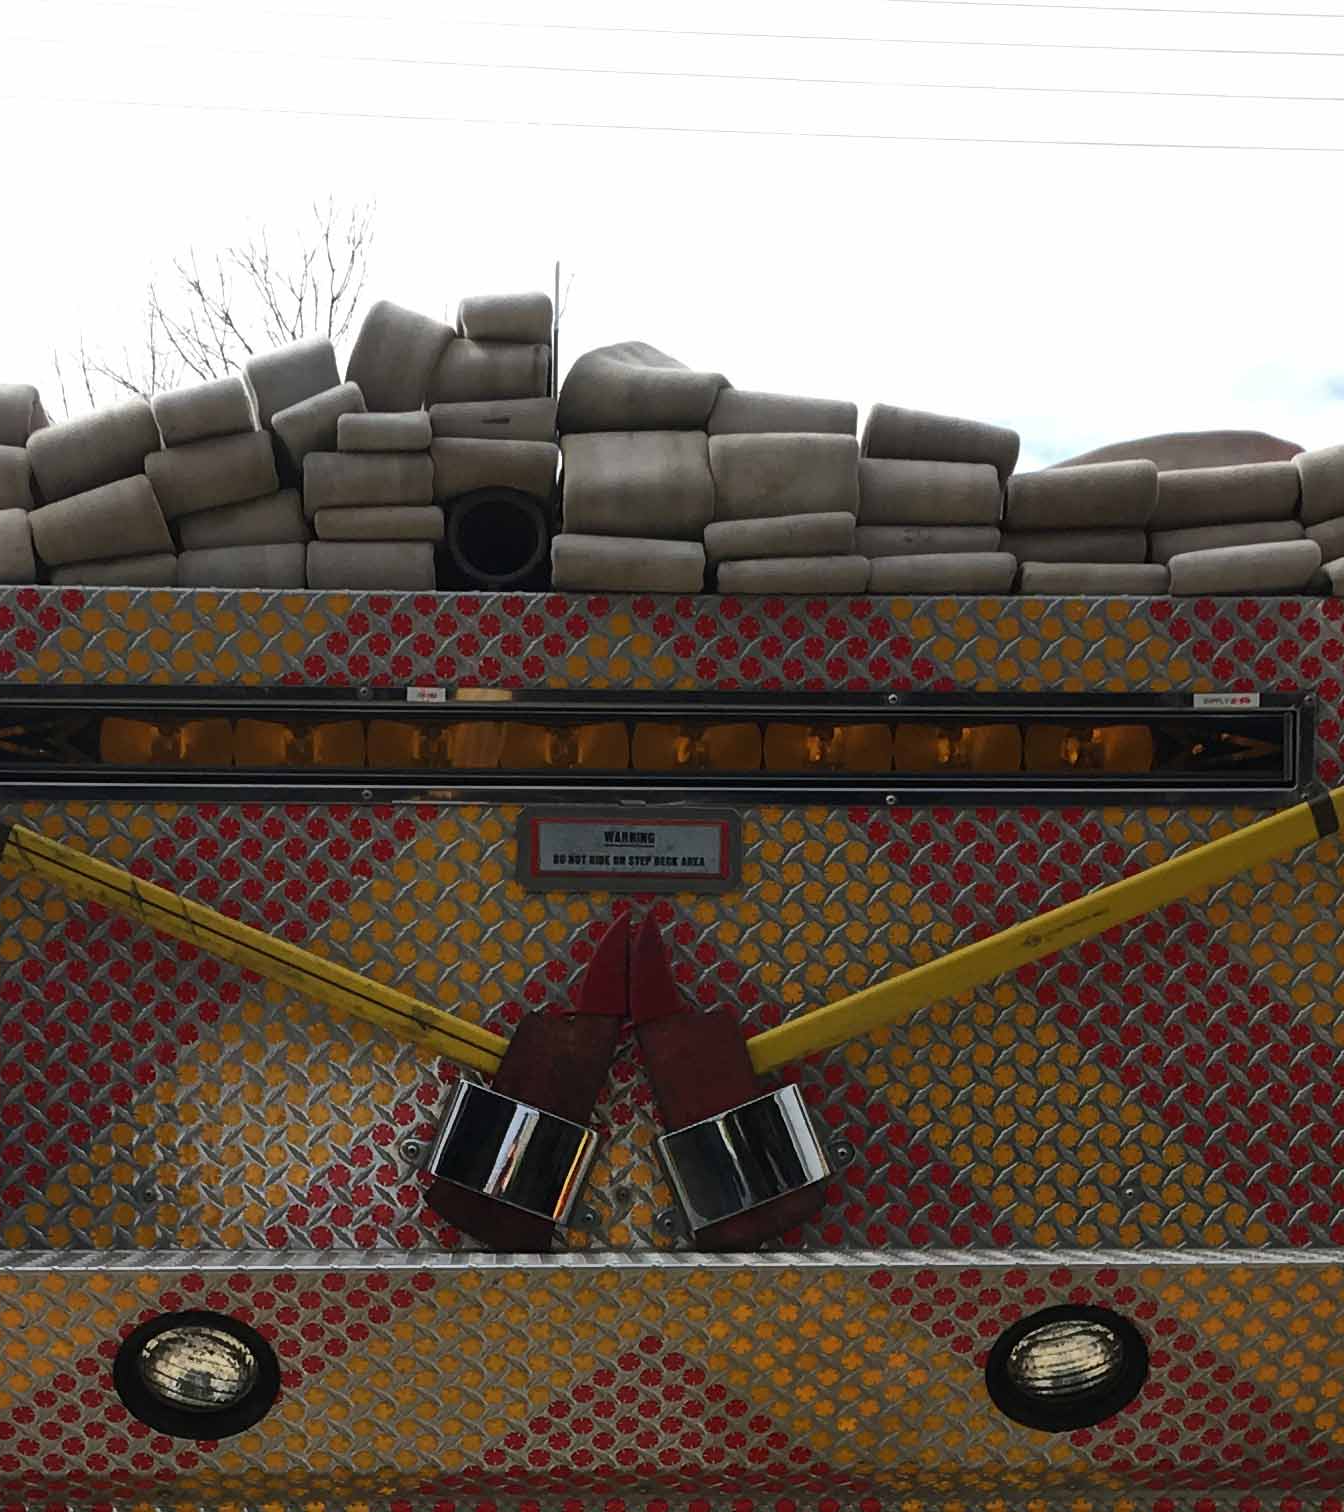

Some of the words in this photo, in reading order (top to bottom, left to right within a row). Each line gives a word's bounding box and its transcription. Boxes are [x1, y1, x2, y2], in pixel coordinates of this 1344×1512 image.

[604, 831, 656, 844] WARNING
[553, 854, 567, 865] DO
[568, 854, 587, 865] NOT
[589, 854, 610, 866] RIDE
[628, 855, 652, 867] STEP
[654, 855, 678, 867] DECK
[681, 855, 705, 867] AREA
